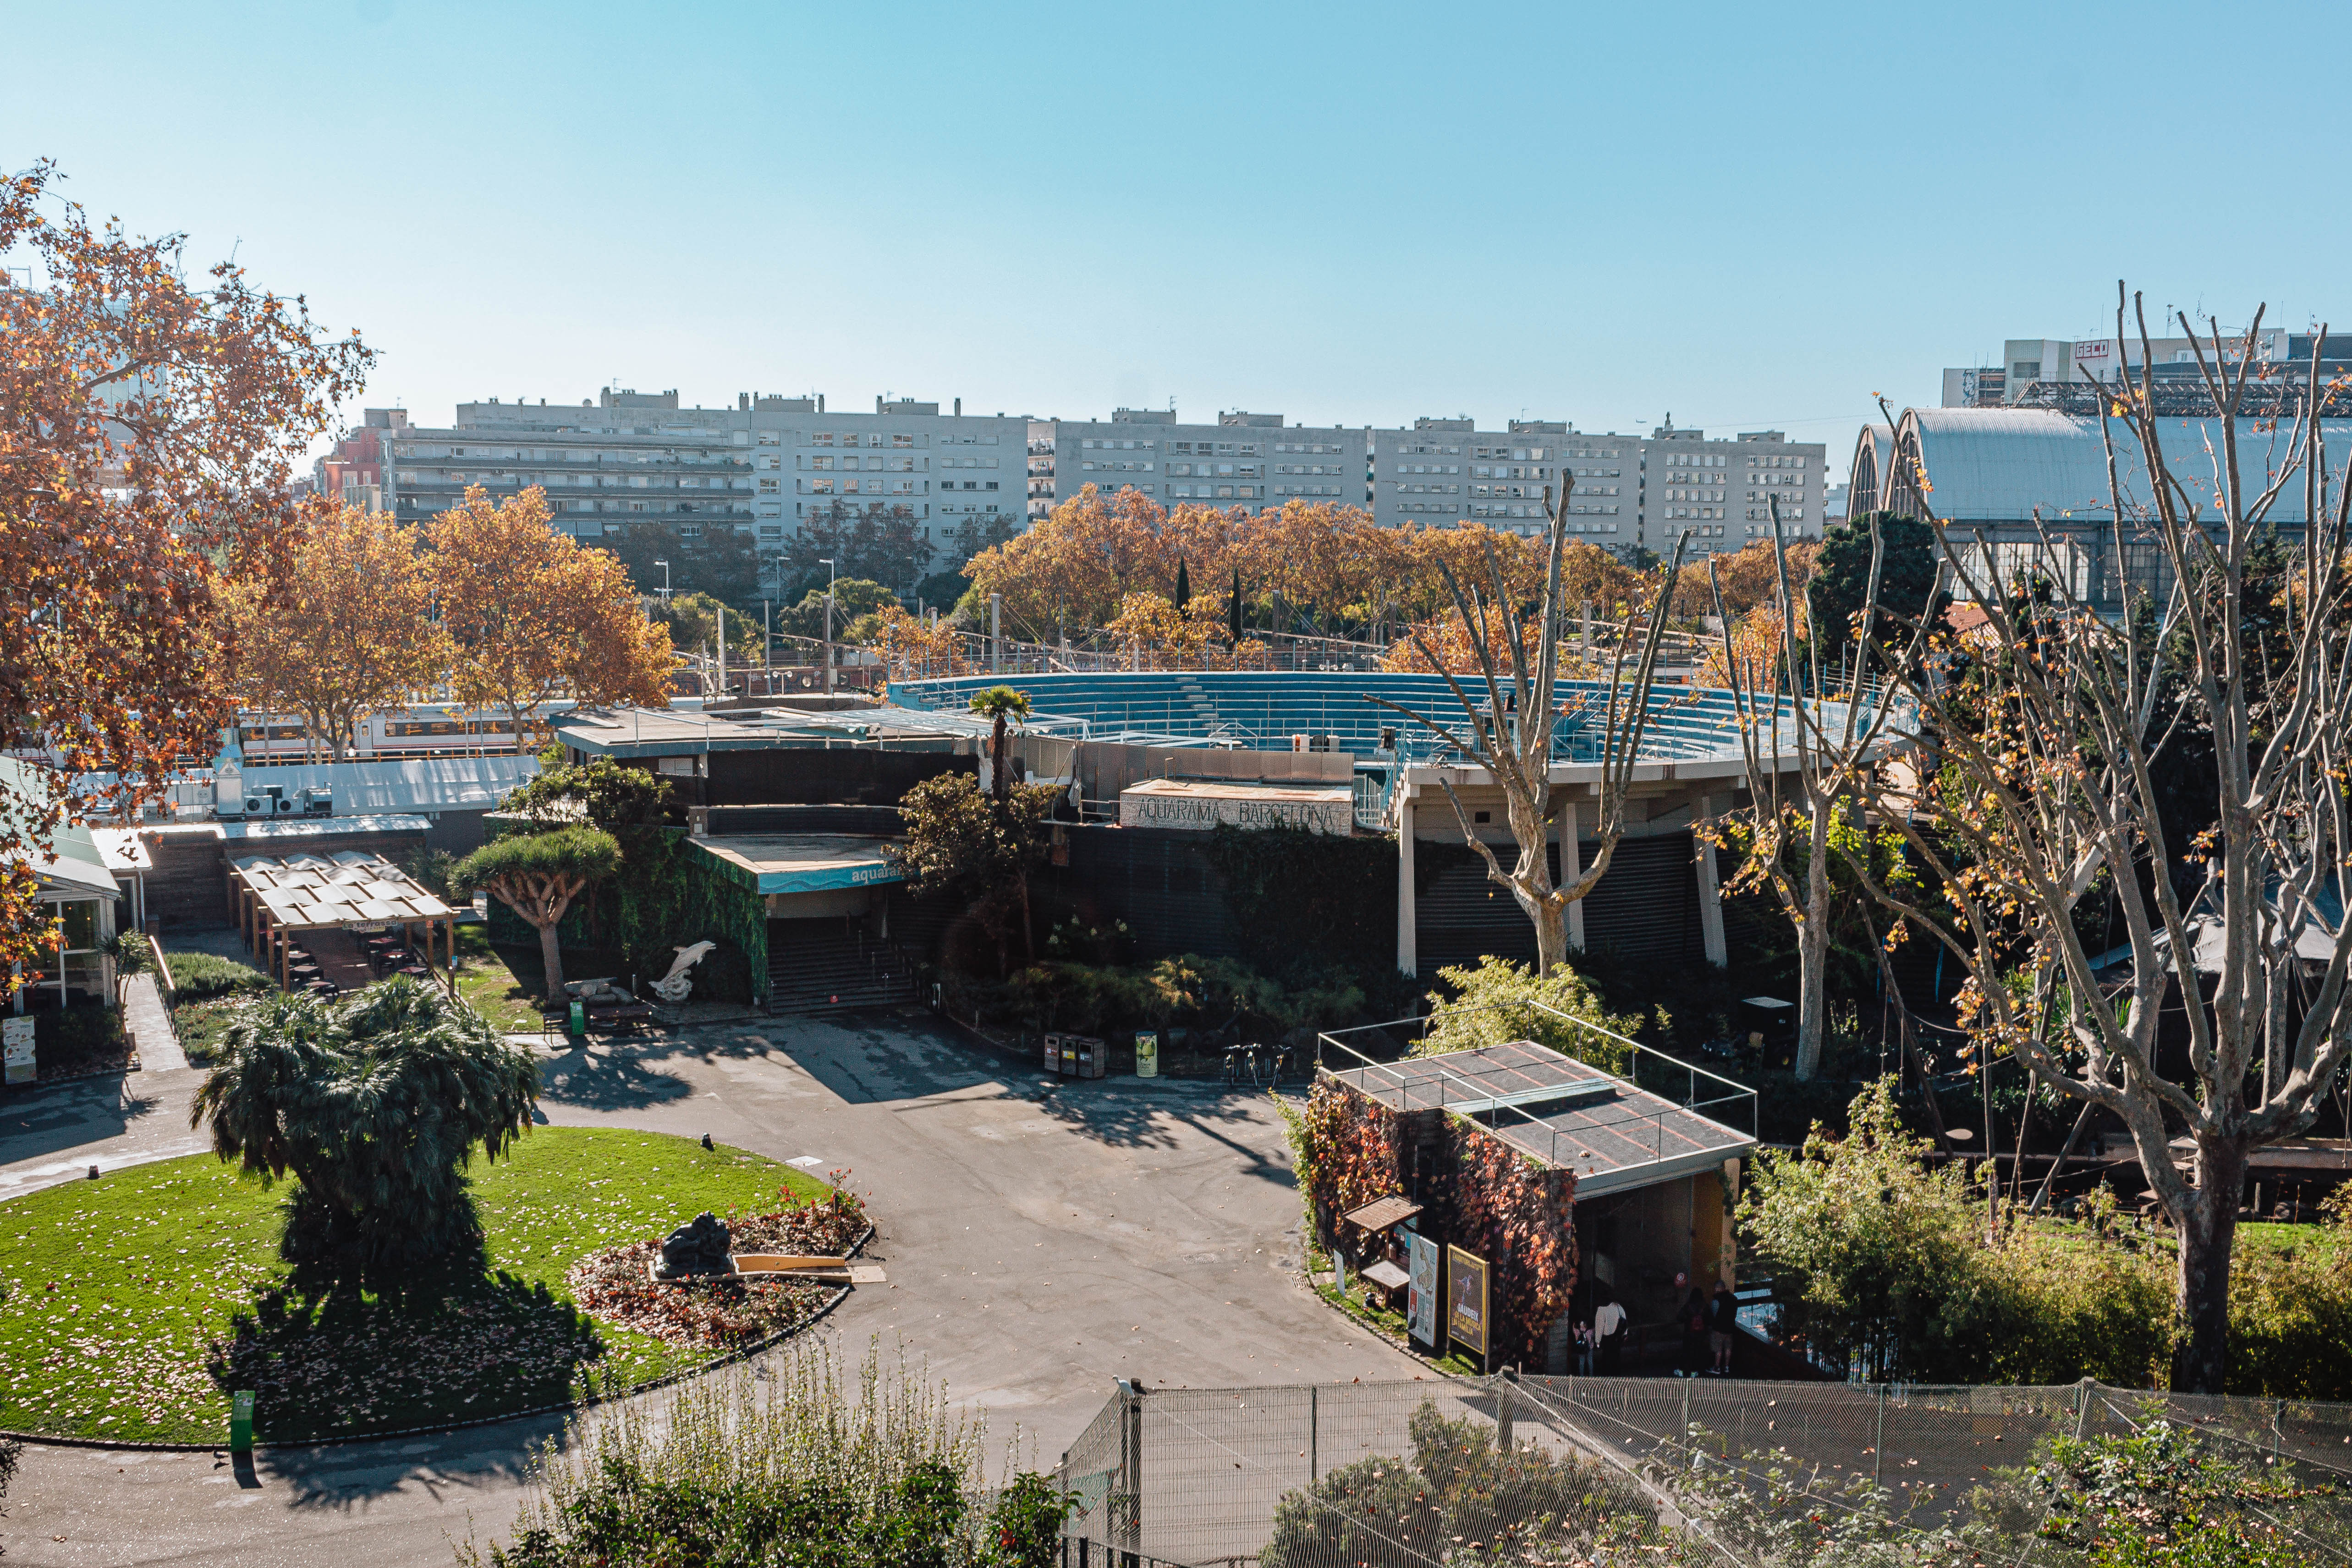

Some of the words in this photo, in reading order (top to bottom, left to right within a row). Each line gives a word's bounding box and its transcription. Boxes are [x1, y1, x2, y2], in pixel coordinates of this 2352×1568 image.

[1138, 798, 1221, 821] AQUARAMA
[1239, 802, 1333, 825] BARCELONA
[1457, 1303, 1478, 1323] GAUDEIX
